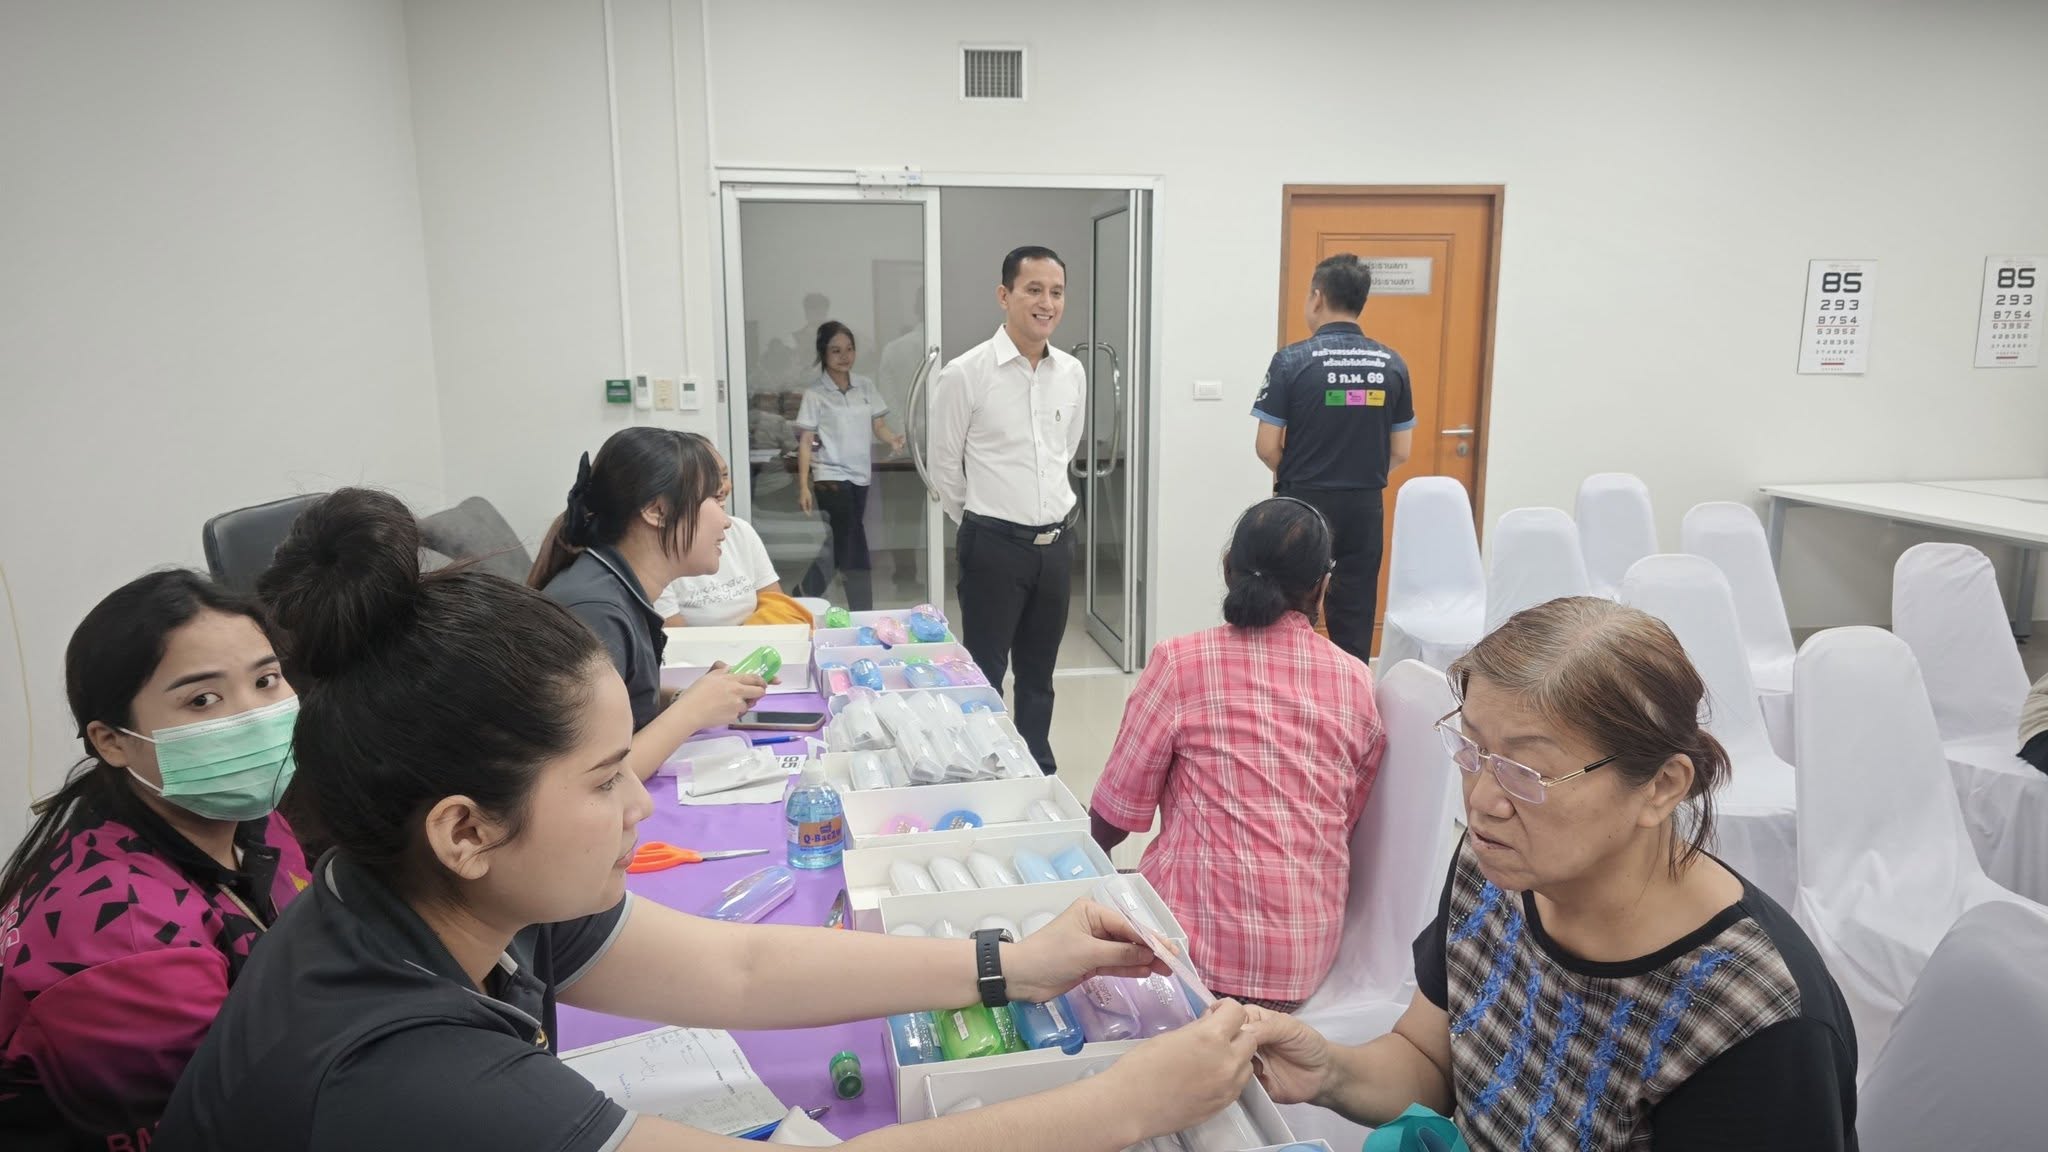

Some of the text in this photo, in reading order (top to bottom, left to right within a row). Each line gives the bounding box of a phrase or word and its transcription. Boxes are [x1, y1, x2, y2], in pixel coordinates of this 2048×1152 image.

[1822, 272, 1863, 293] 85
[1997, 268, 2036, 289] 85
[1327, 372, 1385, 384] 8 ก.พ. 69
